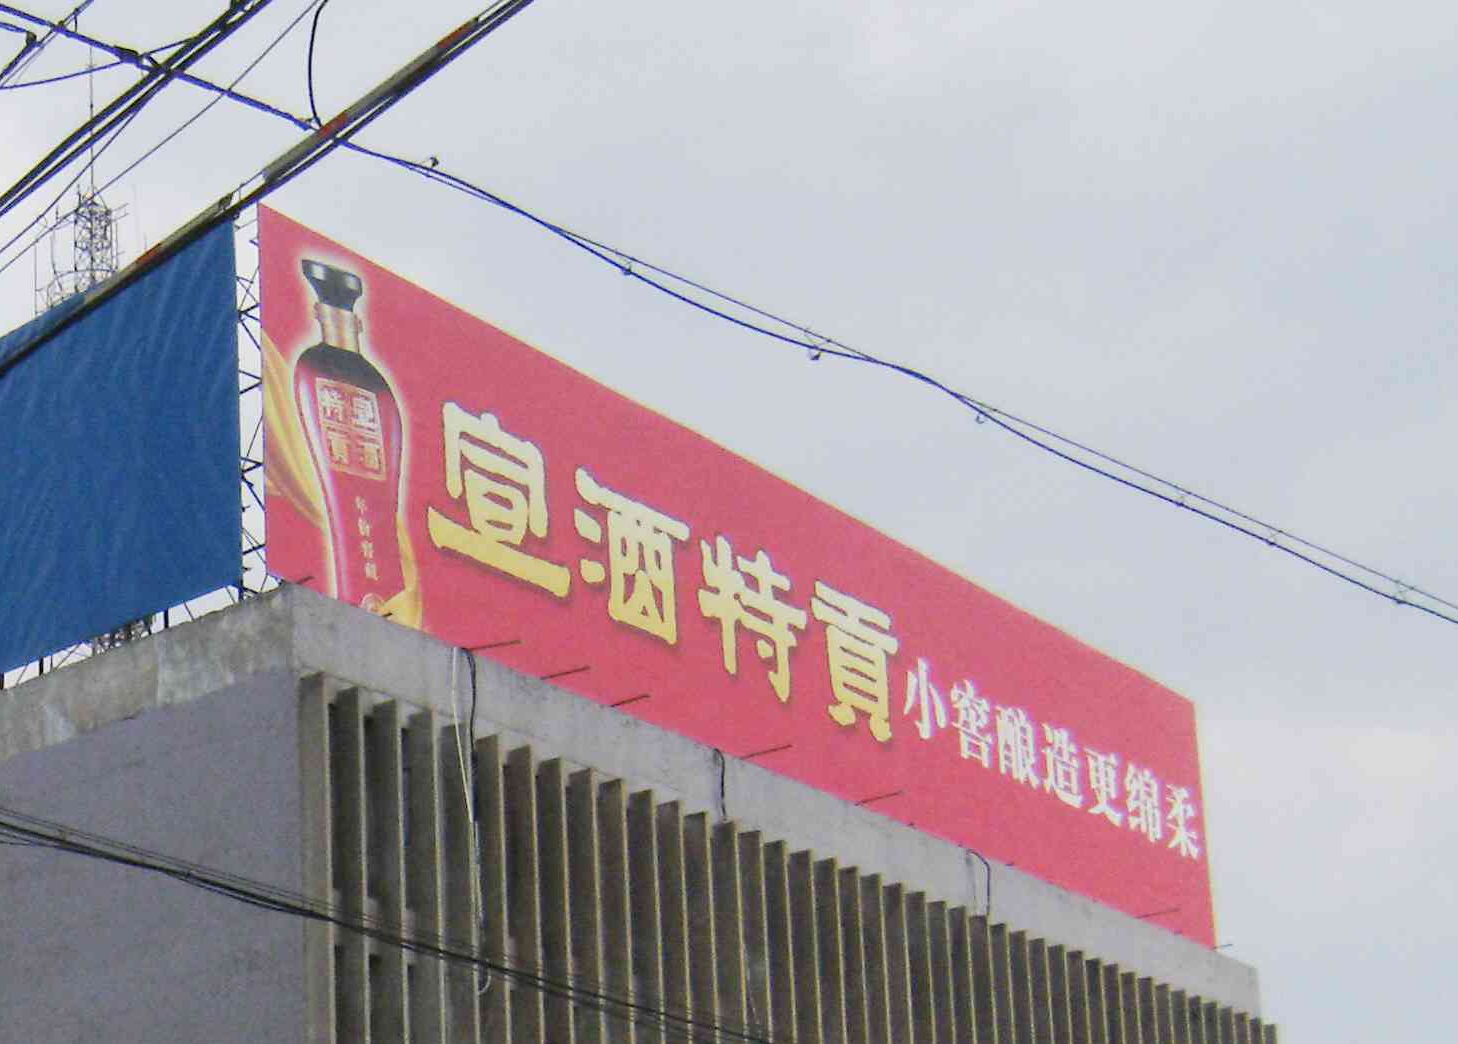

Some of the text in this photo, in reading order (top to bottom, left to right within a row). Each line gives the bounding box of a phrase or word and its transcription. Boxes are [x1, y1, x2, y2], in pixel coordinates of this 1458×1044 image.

[903, 657, 1200, 860] 小窖酿造更绵柔
